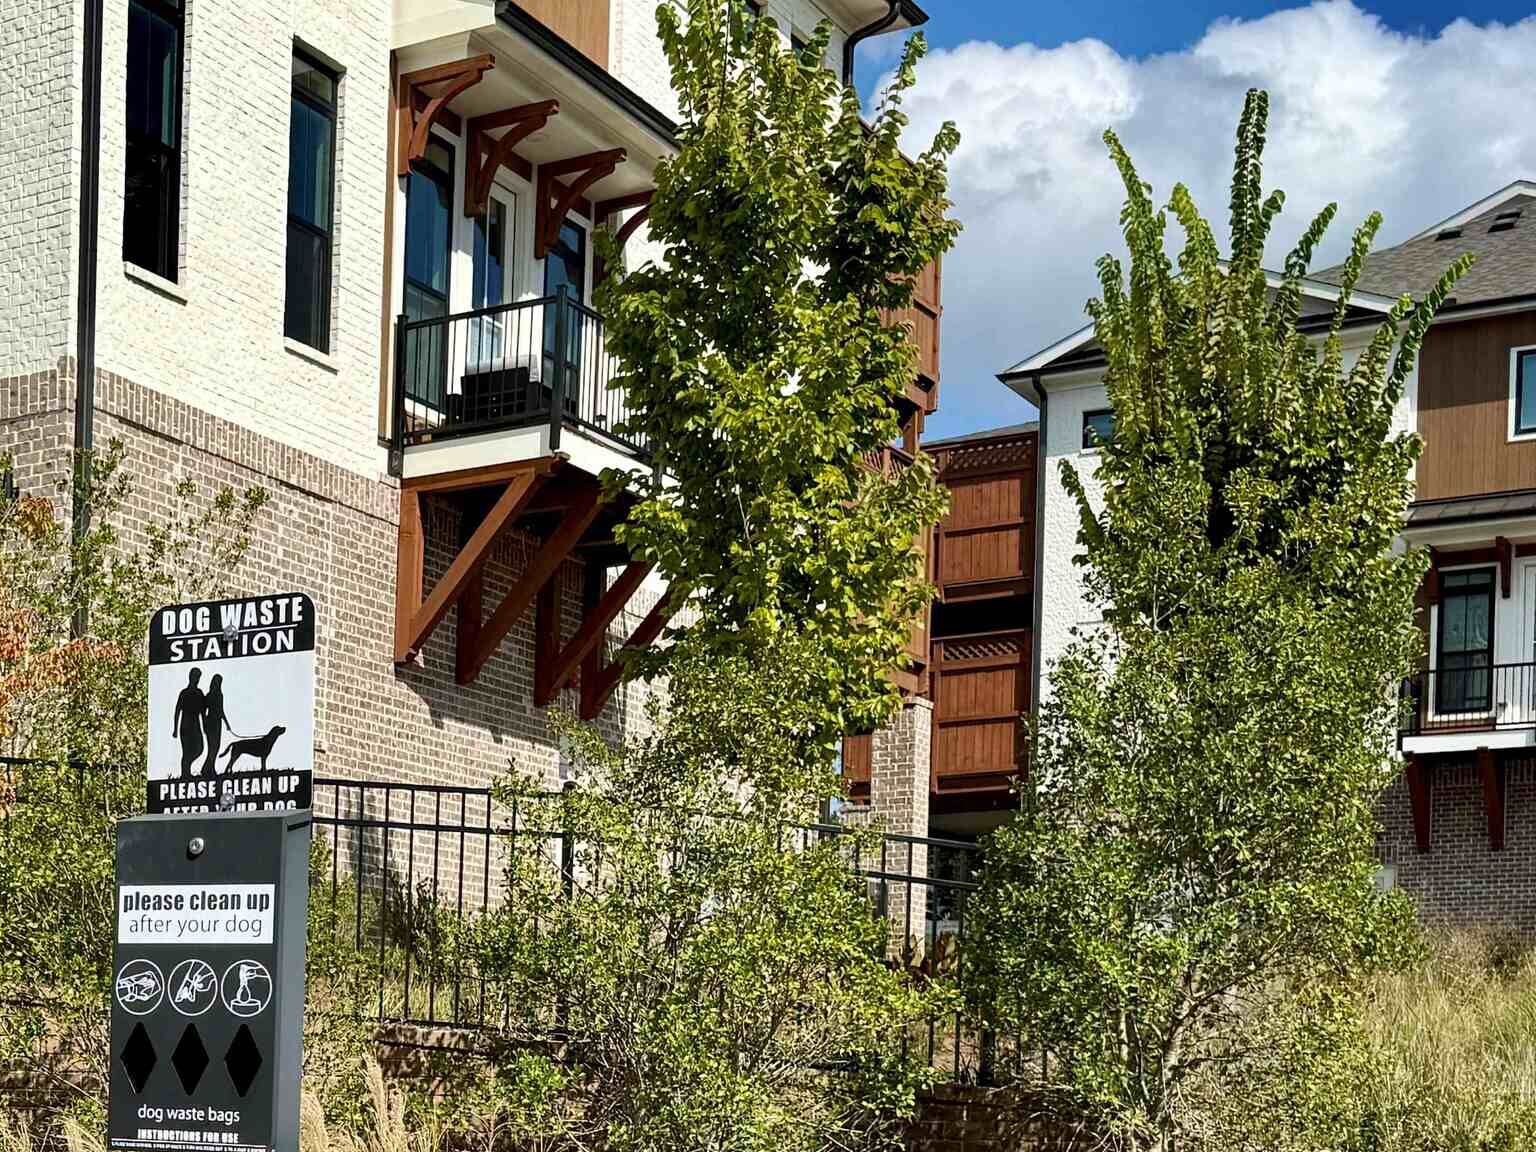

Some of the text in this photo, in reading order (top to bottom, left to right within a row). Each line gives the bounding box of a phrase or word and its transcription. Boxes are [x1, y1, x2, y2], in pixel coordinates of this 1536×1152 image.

[162, 597, 303, 635] DOG WASTE
[170, 629, 294, 662] STATION
[160, 775, 300, 801] PLEASE CLEAN UP
[123, 891, 270, 912] please clean up
[129, 914, 262, 938] after your dog
[137, 1104, 240, 1125] dog waste bags
[137, 1128, 239, 1144] INSTRUCTIONS FOR USE
